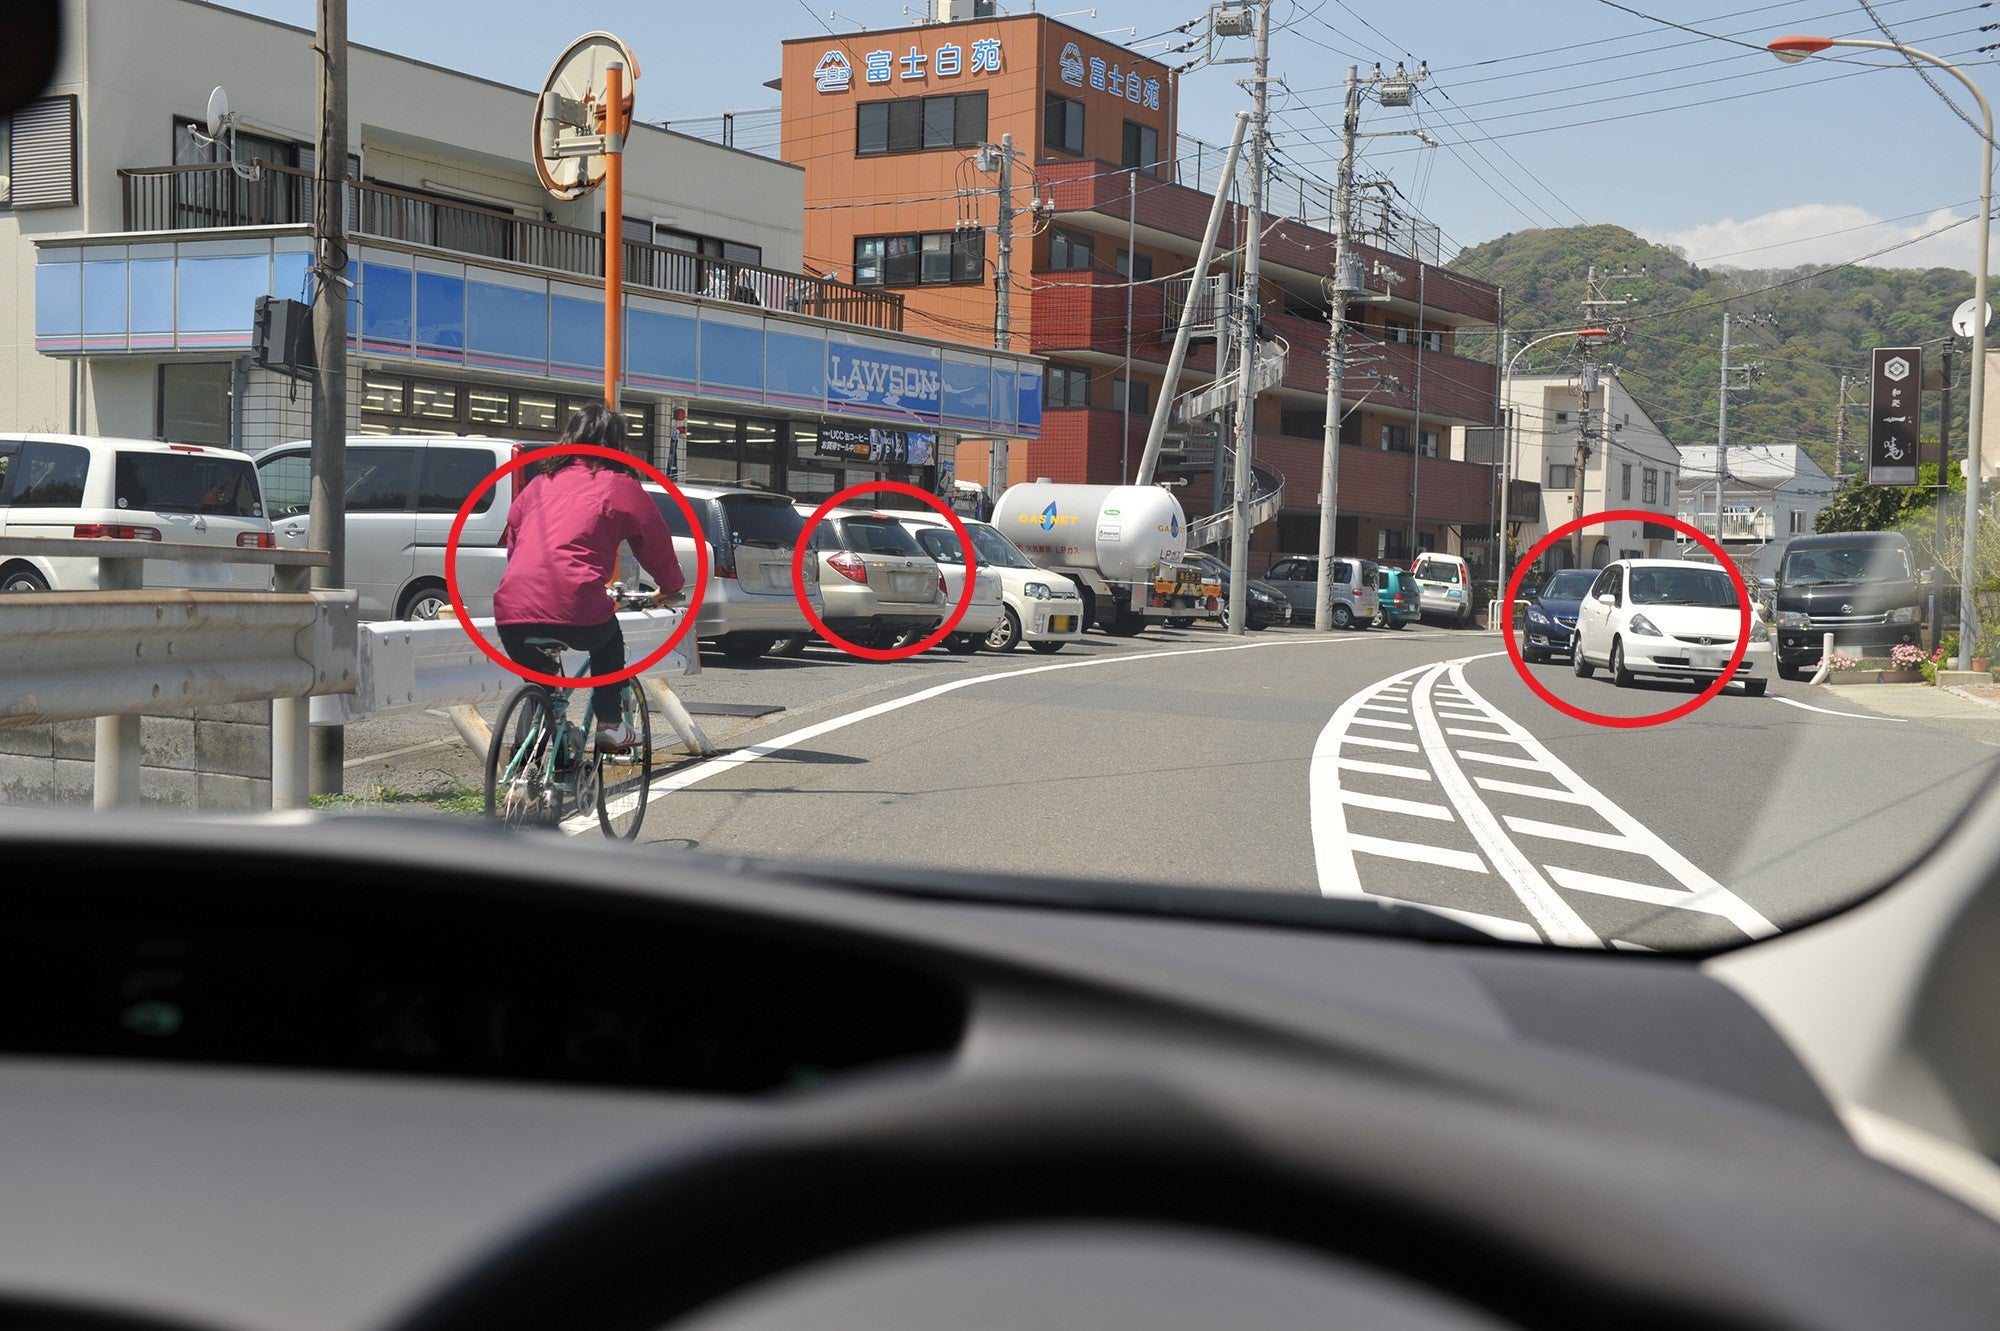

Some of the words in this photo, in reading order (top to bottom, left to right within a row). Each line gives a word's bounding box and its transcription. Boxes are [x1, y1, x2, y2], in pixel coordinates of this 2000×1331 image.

[866, 38, 1001, 83] 富士白苑
[1090, 57, 1159, 111] 富士白苑
[832, 355, 938, 400] LAWSON
[1018, 513, 1047, 524] GAS
[1050, 514, 1079, 525] NET
